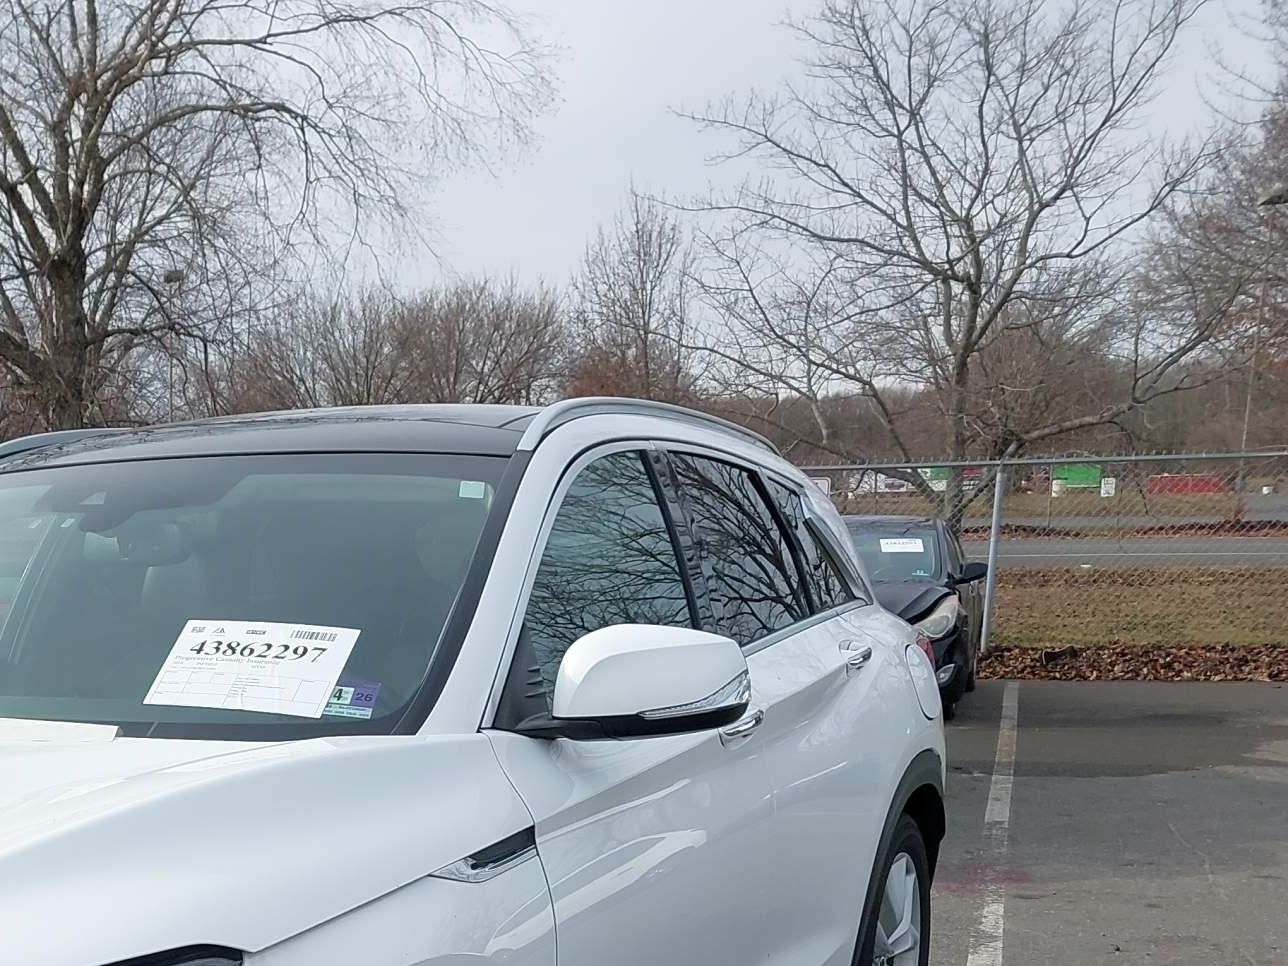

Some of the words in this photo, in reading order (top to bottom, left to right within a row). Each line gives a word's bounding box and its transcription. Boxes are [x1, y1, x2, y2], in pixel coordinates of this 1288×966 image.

[189, 639, 328, 663] 43862297
[333, 688, 344, 701] 4
[354, 692, 373, 702] 26
